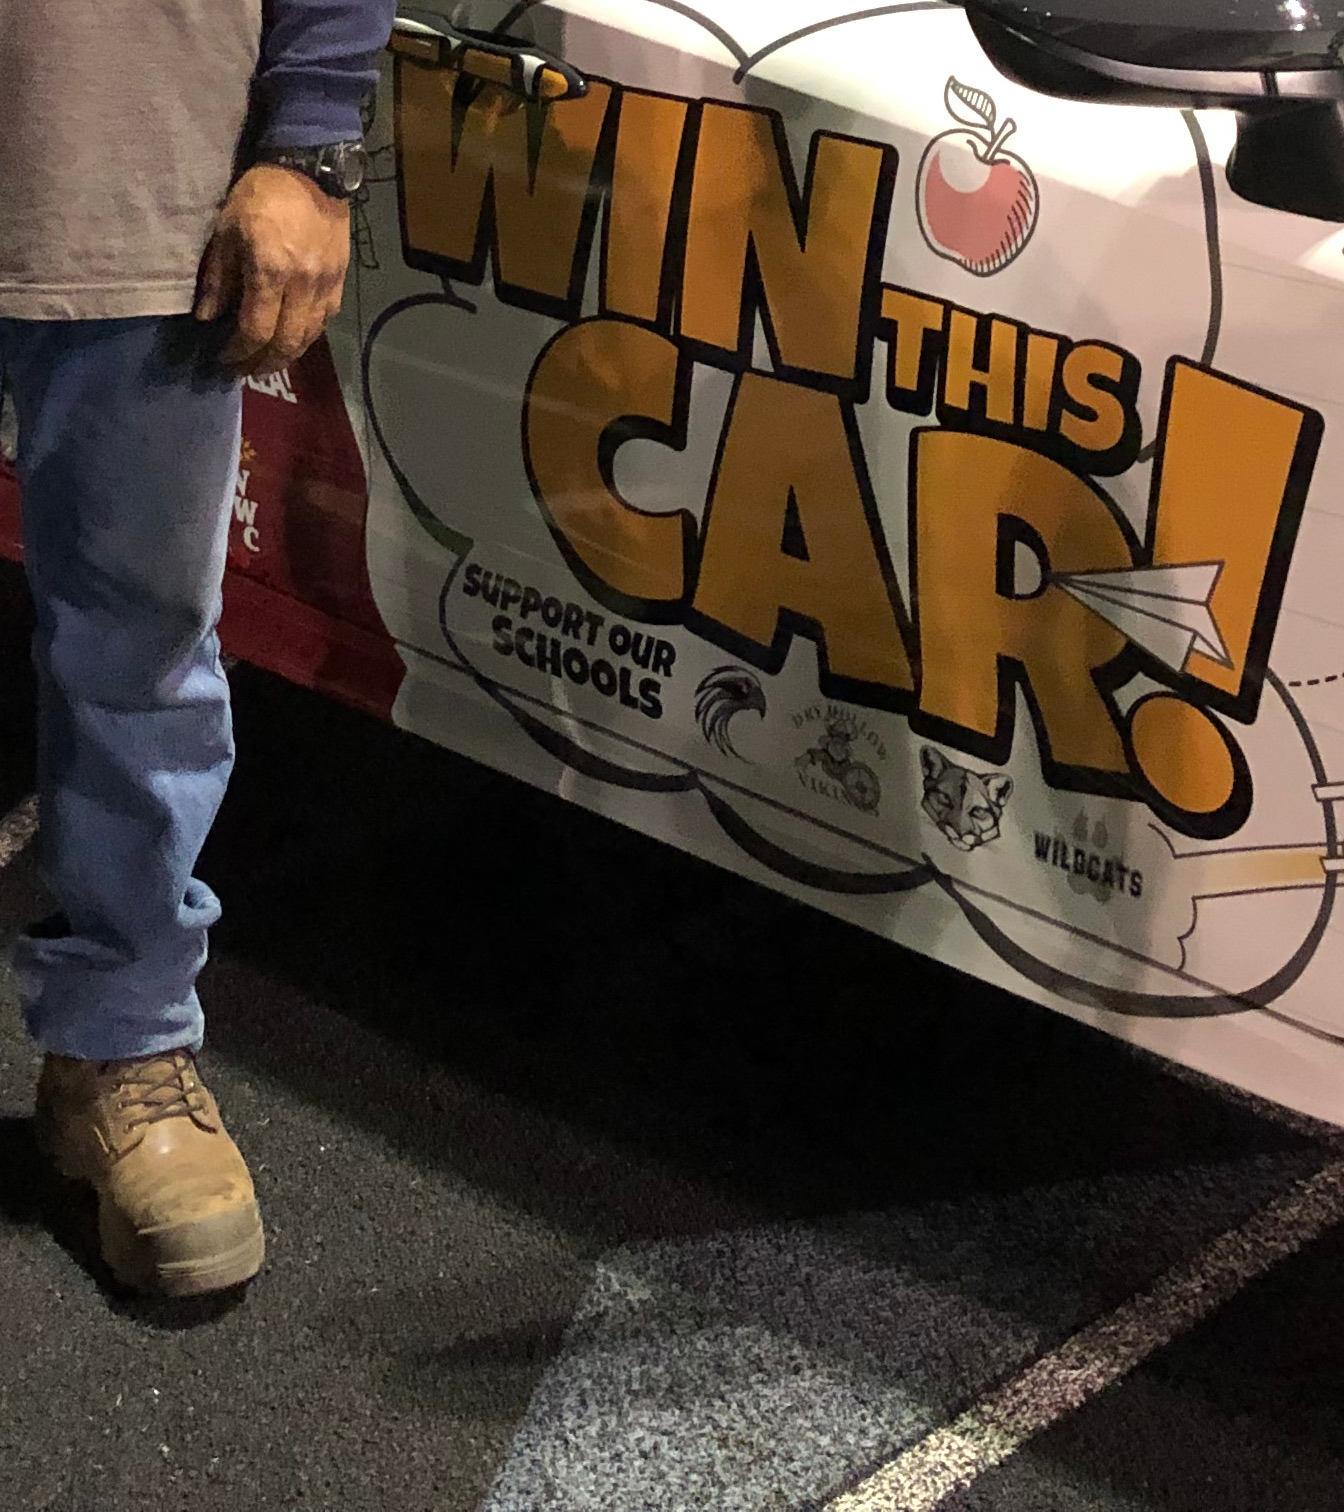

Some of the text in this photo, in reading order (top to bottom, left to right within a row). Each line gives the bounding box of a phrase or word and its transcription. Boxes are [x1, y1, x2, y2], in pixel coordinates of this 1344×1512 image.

[393, 56, 899, 404] WIN
[872, 283, 1142, 476] THIS
[462, 563, 676, 678] SUPPORT OUR
[521, 316, 1325, 840] CAR!
[492, 614, 663, 719] SCHOOLS
[1034, 829, 1143, 898] WILDCATS
